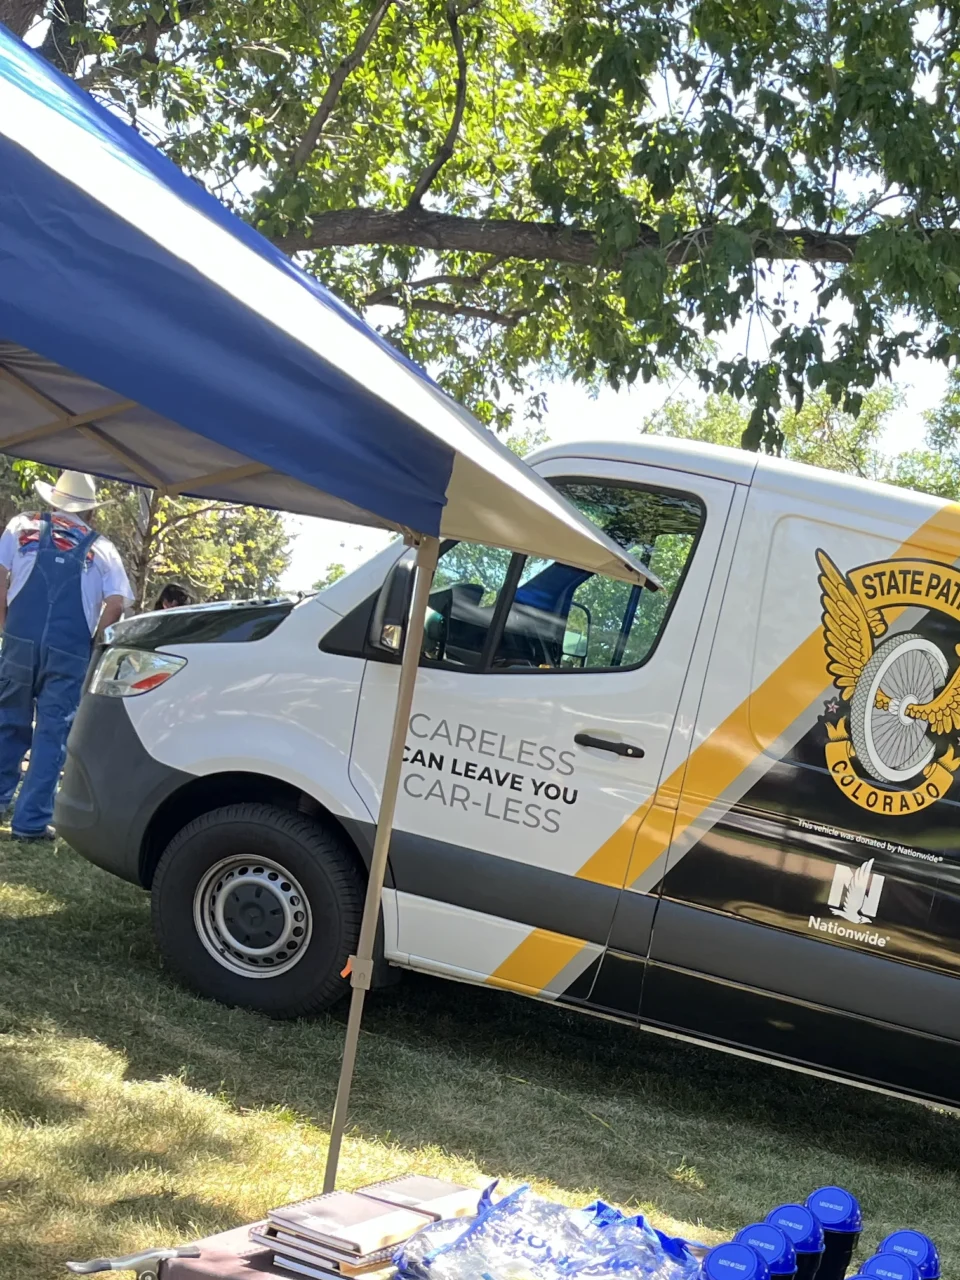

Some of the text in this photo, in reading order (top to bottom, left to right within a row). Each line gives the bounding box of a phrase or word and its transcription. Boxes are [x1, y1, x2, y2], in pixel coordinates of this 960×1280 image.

[861, 569, 925, 599] STATE
[409, 713, 576, 776] CARELESS
[403, 773, 562, 833] CAR-LESS
[451, 758, 524, 792] LEAVE
[531, 778, 578, 805] YOU
[831, 759, 940, 812] COLORADO
[798, 820, 813, 830] This
[814, 822, 839, 837] vehicle
[840, 831, 855, 841] was
[855, 835, 886, 849] donated
[887, 843, 897, 853] by
